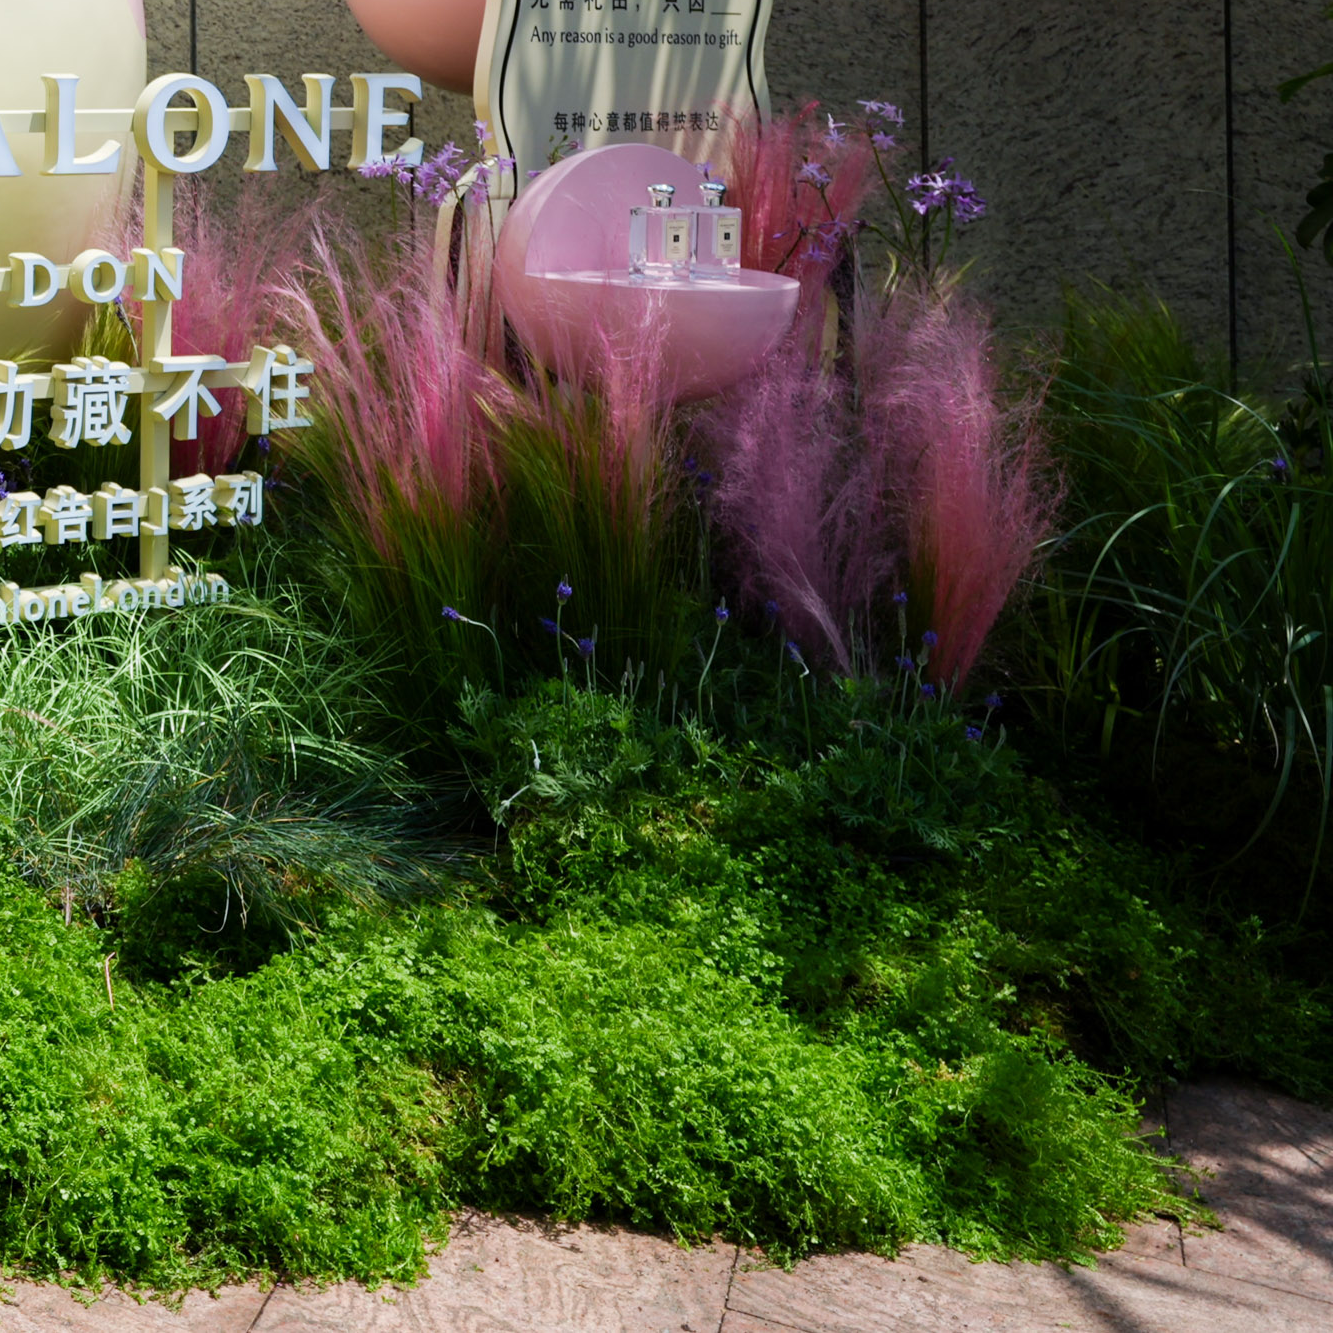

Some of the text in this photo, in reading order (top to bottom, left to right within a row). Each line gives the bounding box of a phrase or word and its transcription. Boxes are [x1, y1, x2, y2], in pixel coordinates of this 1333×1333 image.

[530, 25, 742, 49] Any reason is a good reason to gift.
